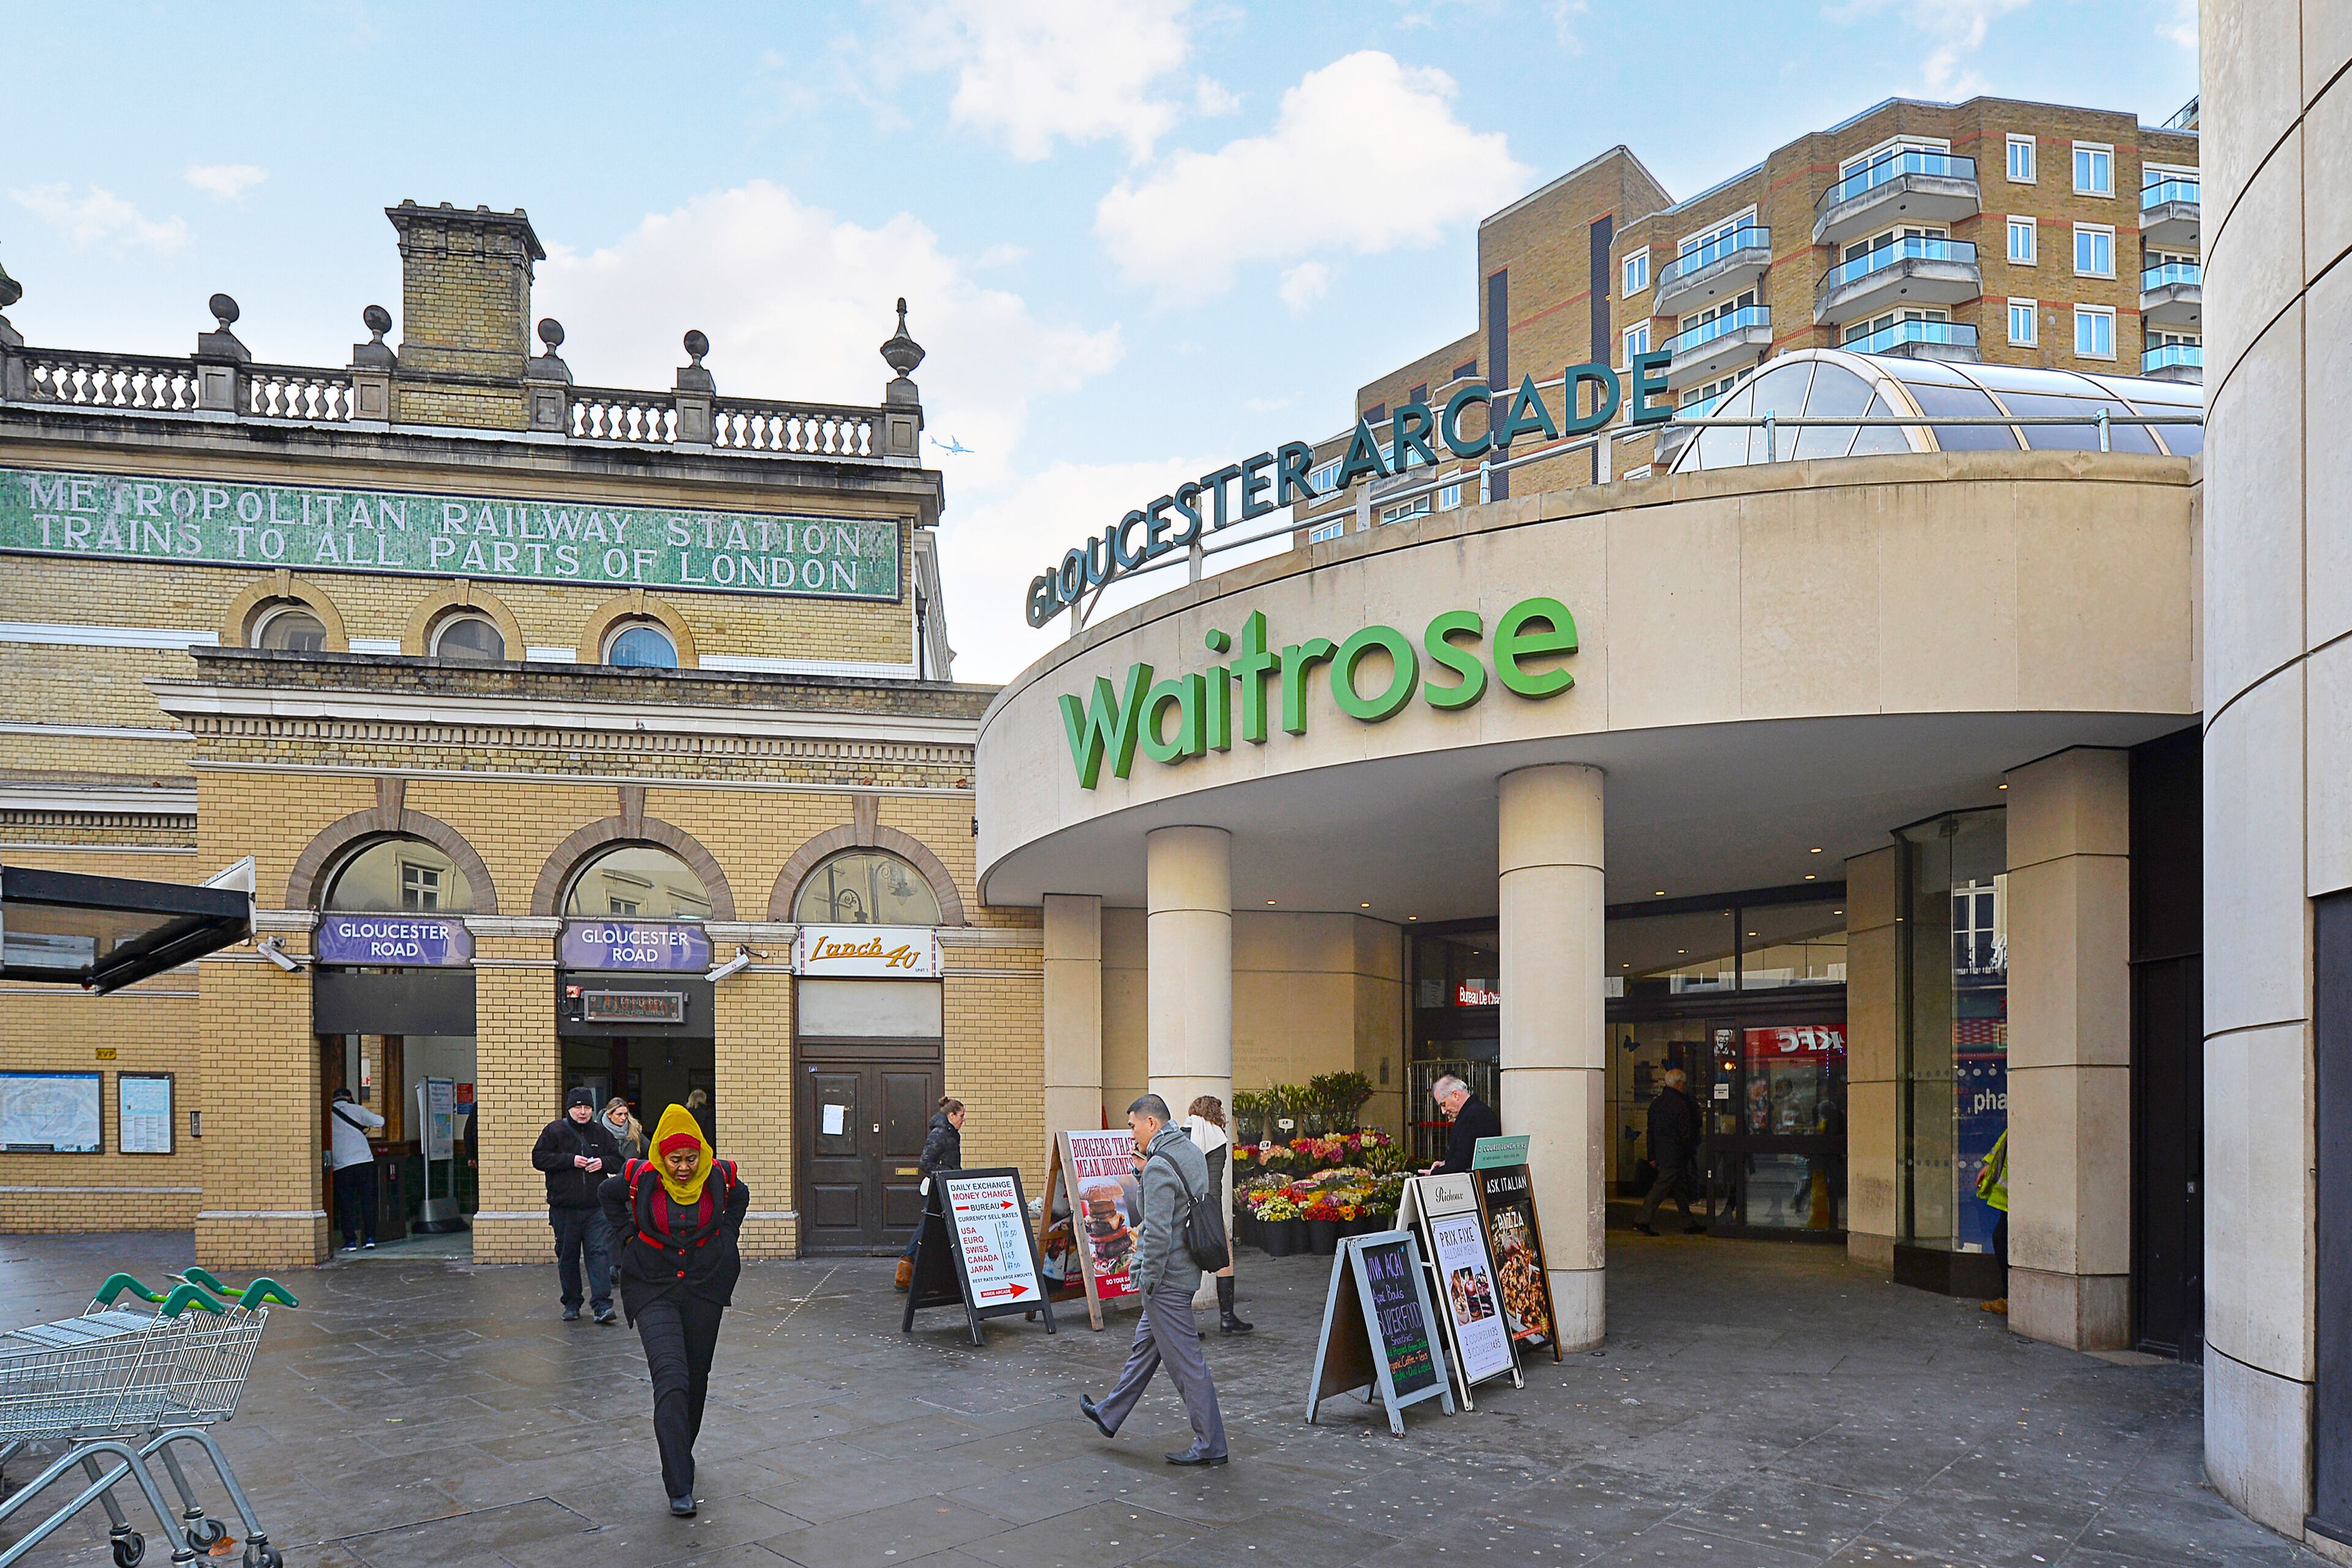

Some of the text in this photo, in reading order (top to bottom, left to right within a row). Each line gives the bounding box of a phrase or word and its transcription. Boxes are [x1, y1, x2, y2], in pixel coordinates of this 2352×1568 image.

[1027, 350, 1673, 629] GLOUCESTER ARCADE
[29, 477, 860, 556] METROPOLITAN RAILWAY STATION
[32, 513, 856, 590] TRAINS TO ALL PARTS OF LONDON
[1058, 597, 1579, 790] Waitrose
[339, 923, 449, 940] GLOUCESTER
[581, 929, 688, 946] GLOUCESTER
[371, 941, 418, 957] ROAD
[612, 948, 658, 962] ROAD
[809, 935, 883, 962] Lunch
[1460, 986, 1478, 1005] Bureau
[1479, 990, 1487, 1005] De
[1071, 1137, 1110, 1158] BURGERS
[1076, 1159, 1101, 1178] MEAN
[973, 1181, 1011, 1190] EXCHANGE
[1487, 1175, 1527, 1194] ASK ITALIAN
[952, 1189, 1013, 1201] MONEY CHANGE
[1436, 1186, 1464, 1203] Richoux
[970, 1202, 1000, 1212] BUREAU
[1496, 1210, 1524, 1232] PIZZA
[1440, 1226, 1474, 1248] PRIX FIXE
[965, 1245, 989, 1254] SWISS
[1444, 1244, 1477, 1260] ALL DAY MENU
[967, 1254, 999, 1264] CANADA
[970, 1264, 994, 1274] JAPAN
[1365, 1256, 1385, 1282] VIVA
[1377, 1301, 1423, 1338] SUPERFOOD
[1391, 1333, 1414, 1346] Smoothies
[1465, 1336, 1469, 1346] 2
[1468, 1349, 1471, 1359] 3
